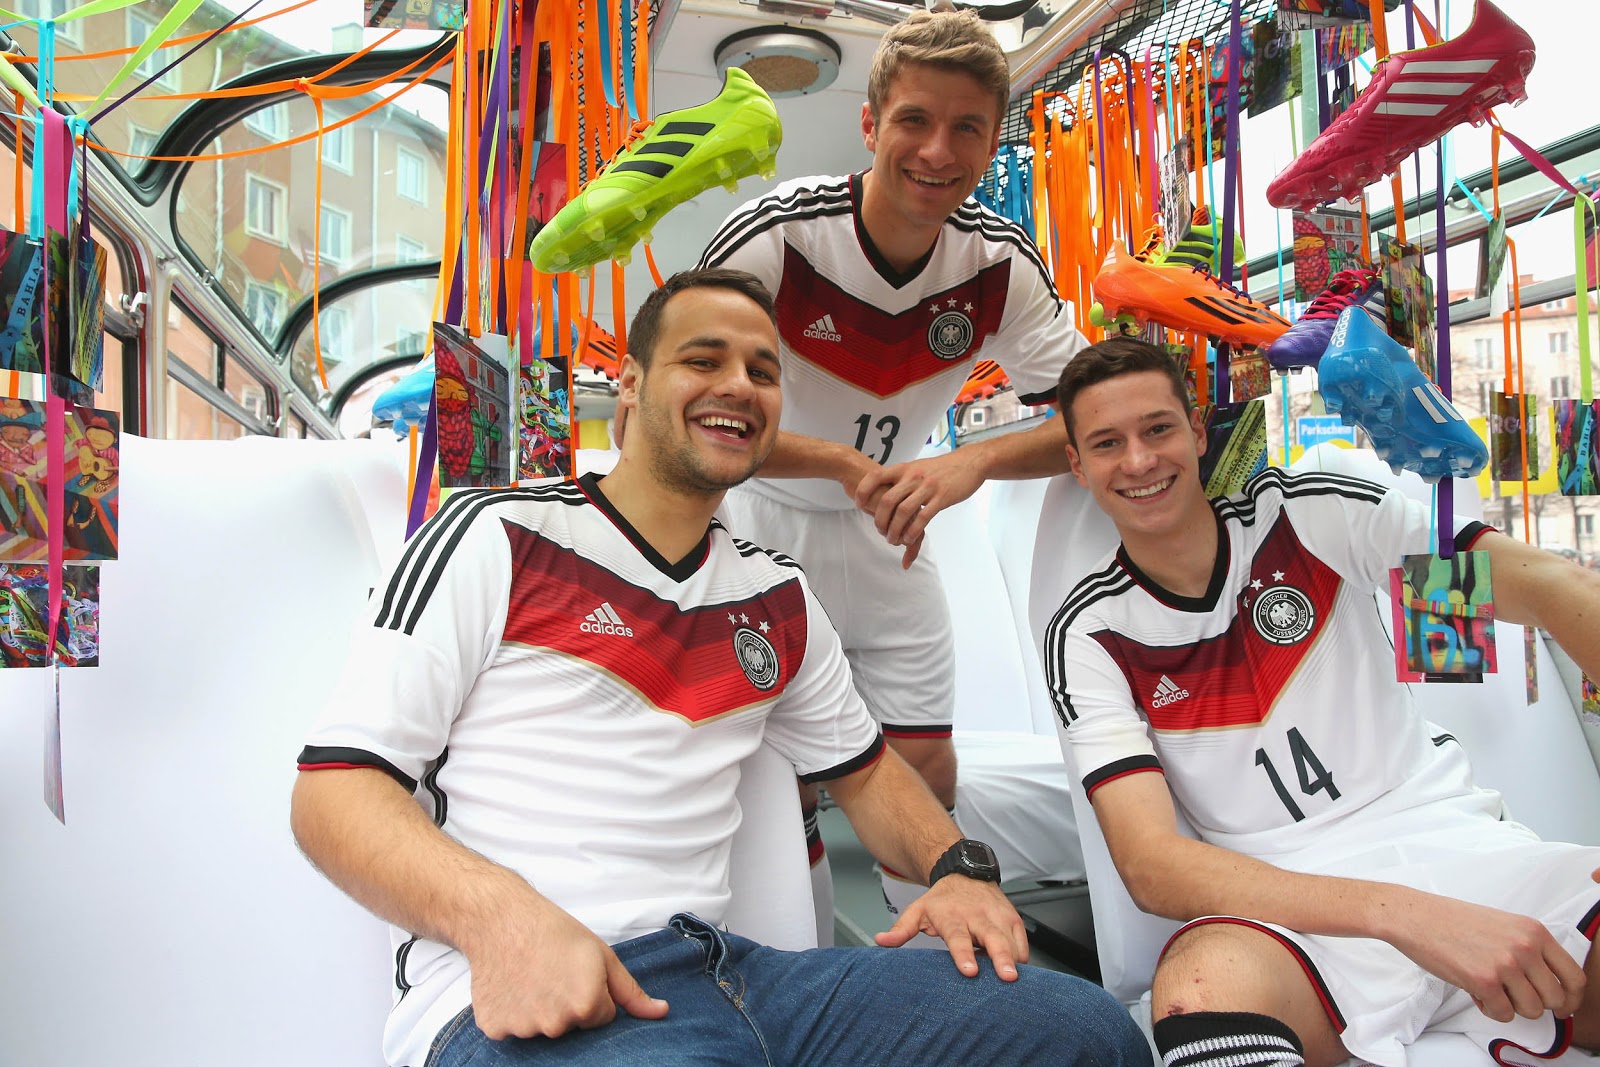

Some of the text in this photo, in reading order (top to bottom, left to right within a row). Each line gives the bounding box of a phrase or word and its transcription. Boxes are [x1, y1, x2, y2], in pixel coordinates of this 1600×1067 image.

[17, 267, 40, 317] BAHIA
[803, 328, 842, 343] adidas
[1335, 308, 1351, 348] adidas
[854, 413, 901, 466] 13
[1260, 593, 1288, 616] DEUTSCHER
[579, 620, 634, 638] adidas
[1151, 687, 1190, 709] adidas
[1255, 726, 1342, 823] 14
